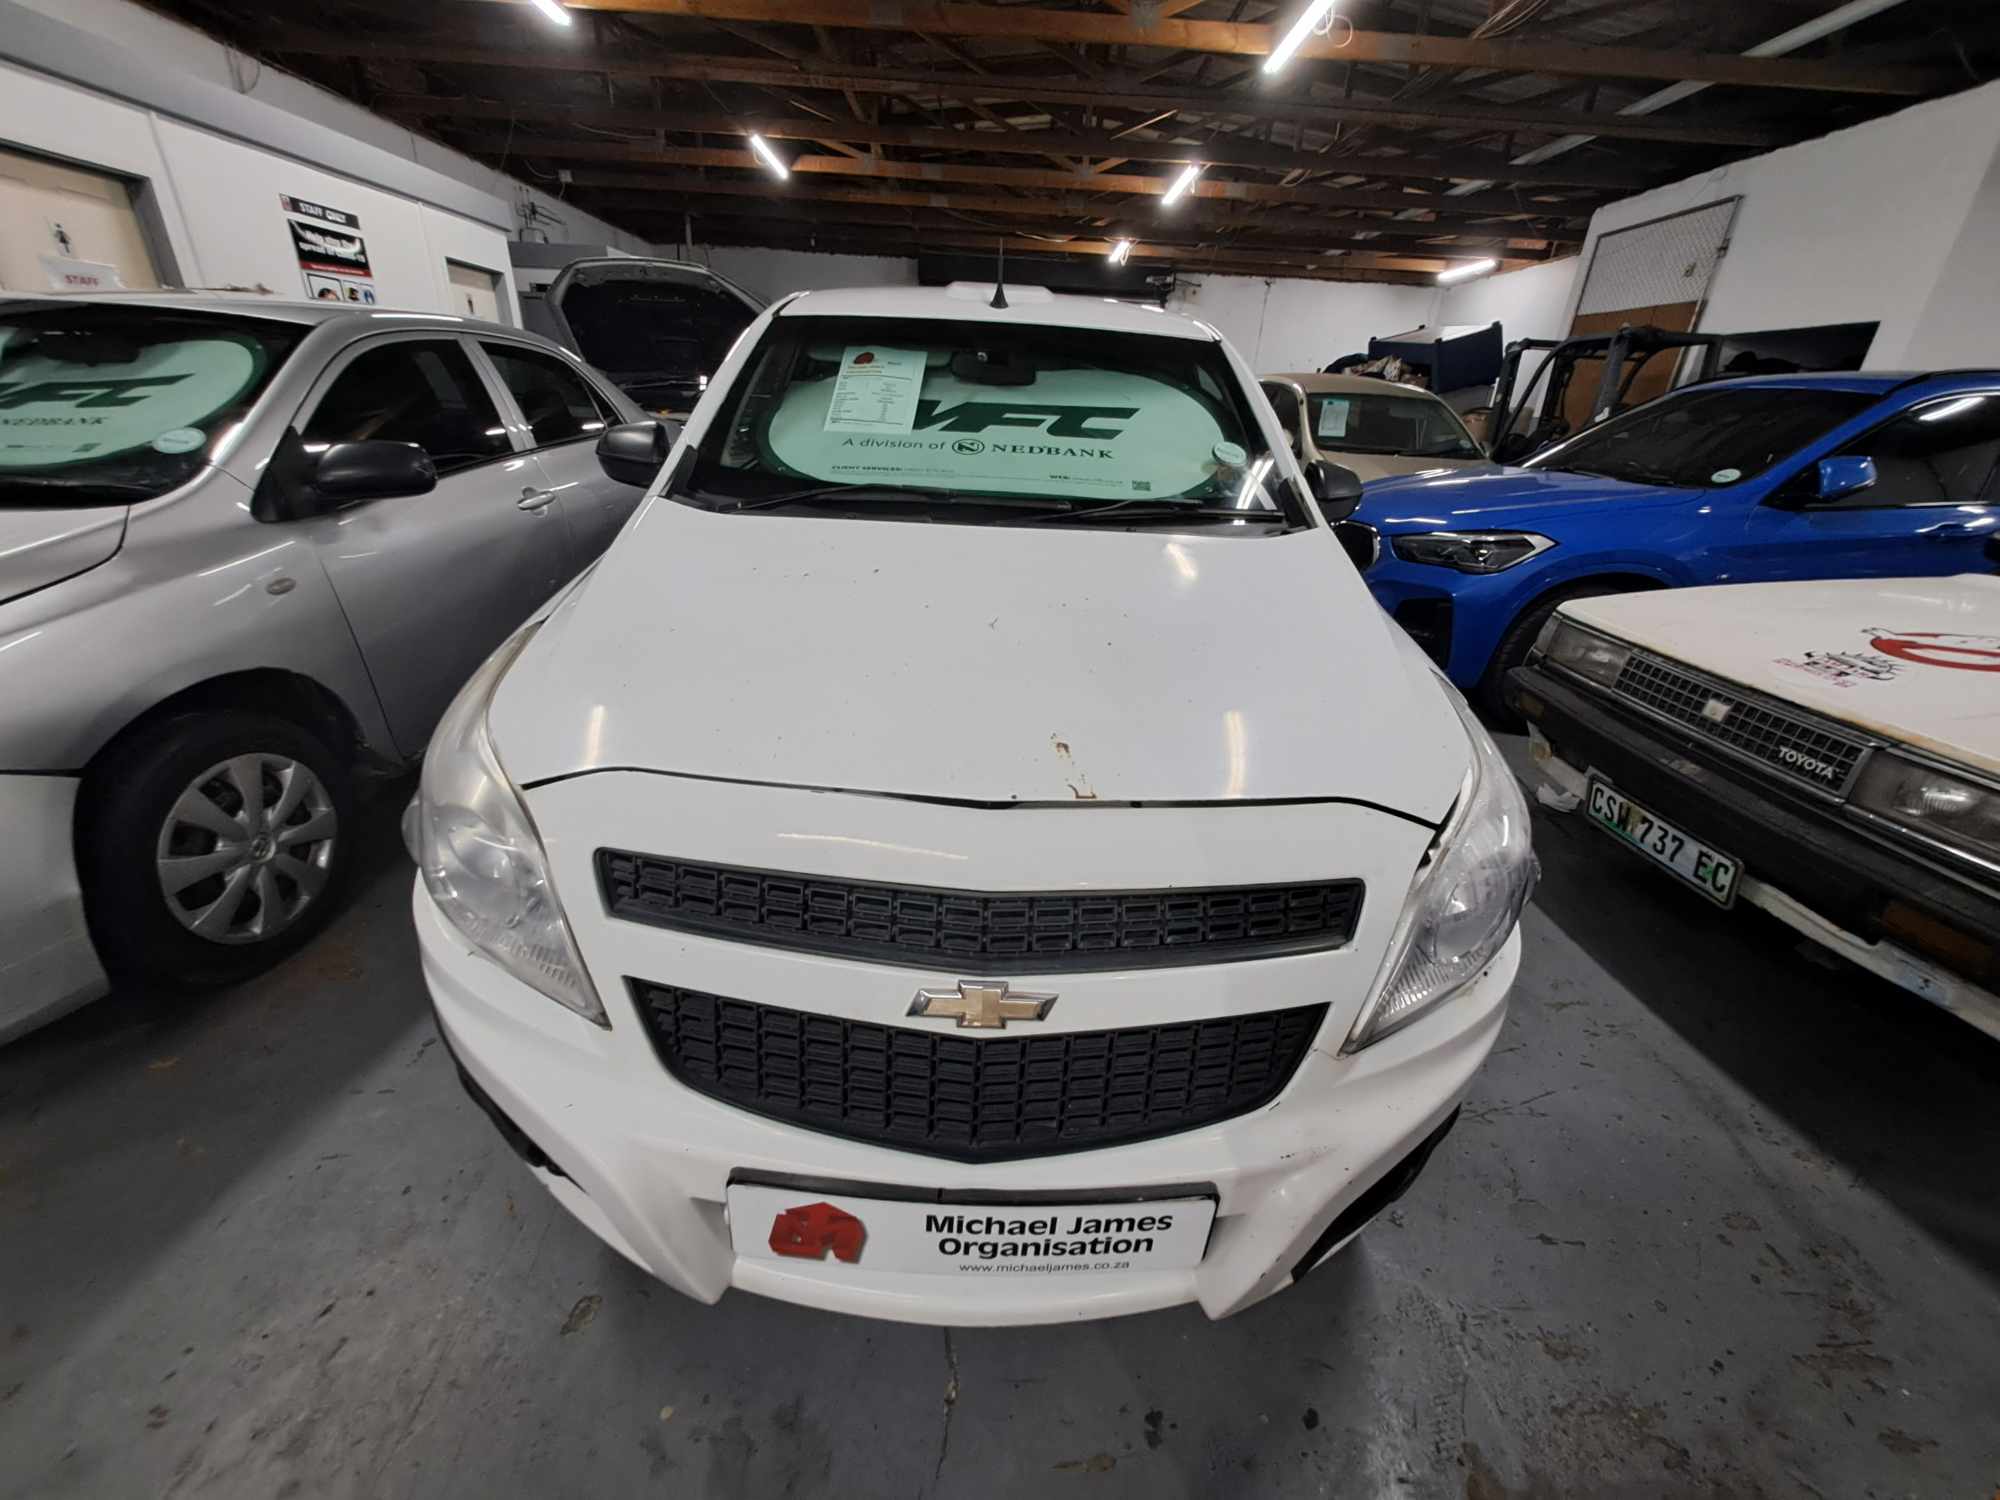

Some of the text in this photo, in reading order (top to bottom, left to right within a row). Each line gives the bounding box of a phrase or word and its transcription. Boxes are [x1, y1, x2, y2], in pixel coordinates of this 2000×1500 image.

[841, 438, 1113, 459] A division of NEDBANK
[1777, 746, 1834, 780] TOYOTA
[1638, 815, 1685, 863] 737
[1693, 851, 1730, 893] EC
[925, 1214, 1173, 1235] Michael James
[938, 1236, 1154, 1260] Organisation
[959, 1261, 1130, 1273] www.michaeljames.co.za
